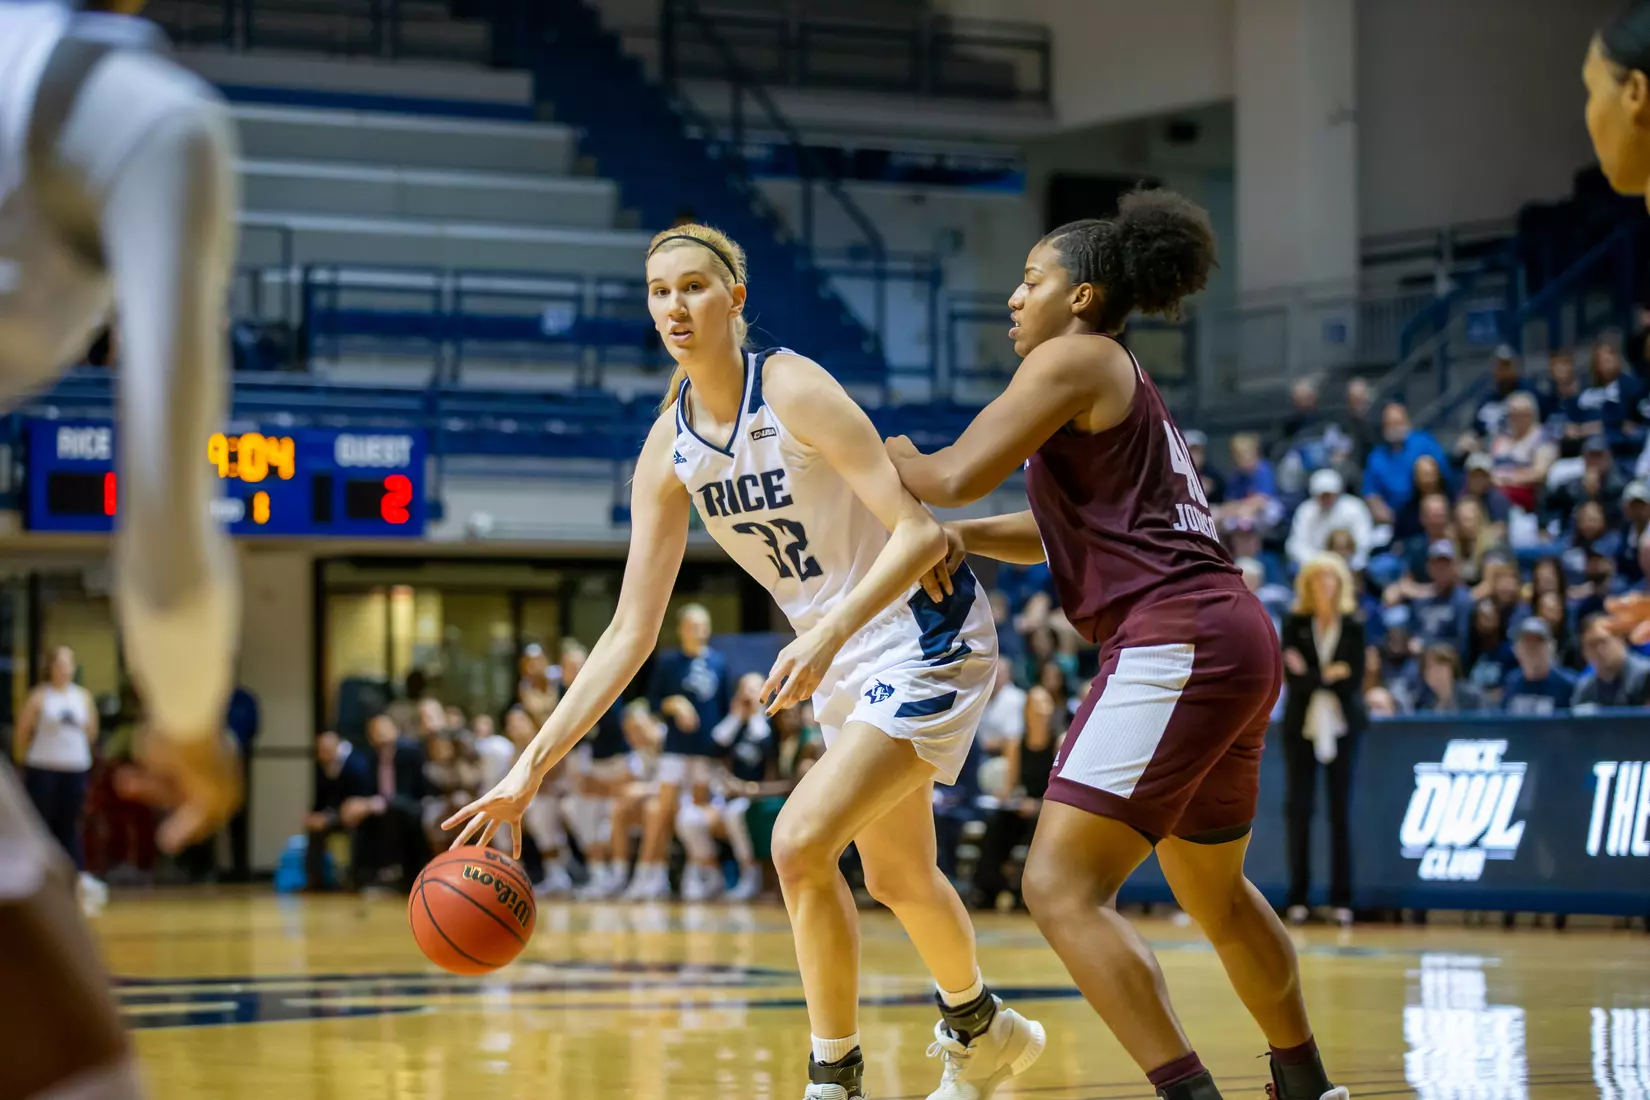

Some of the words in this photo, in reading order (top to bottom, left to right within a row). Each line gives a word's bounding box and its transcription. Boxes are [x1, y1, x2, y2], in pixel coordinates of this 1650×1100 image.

[56, 426, 112, 460] RICE
[207, 432, 295, 483] 9:04
[334, 433, 414, 467] GUEST
[253, 490, 271, 525] 1
[381, 474, 413, 525] 2
[696, 468, 794, 518] RICE
[732, 518, 824, 582] 32
[1400, 772, 1527, 850] OWL
[1418, 848, 1486, 881] CLUB
[463, 864, 530, 930] Wilson
